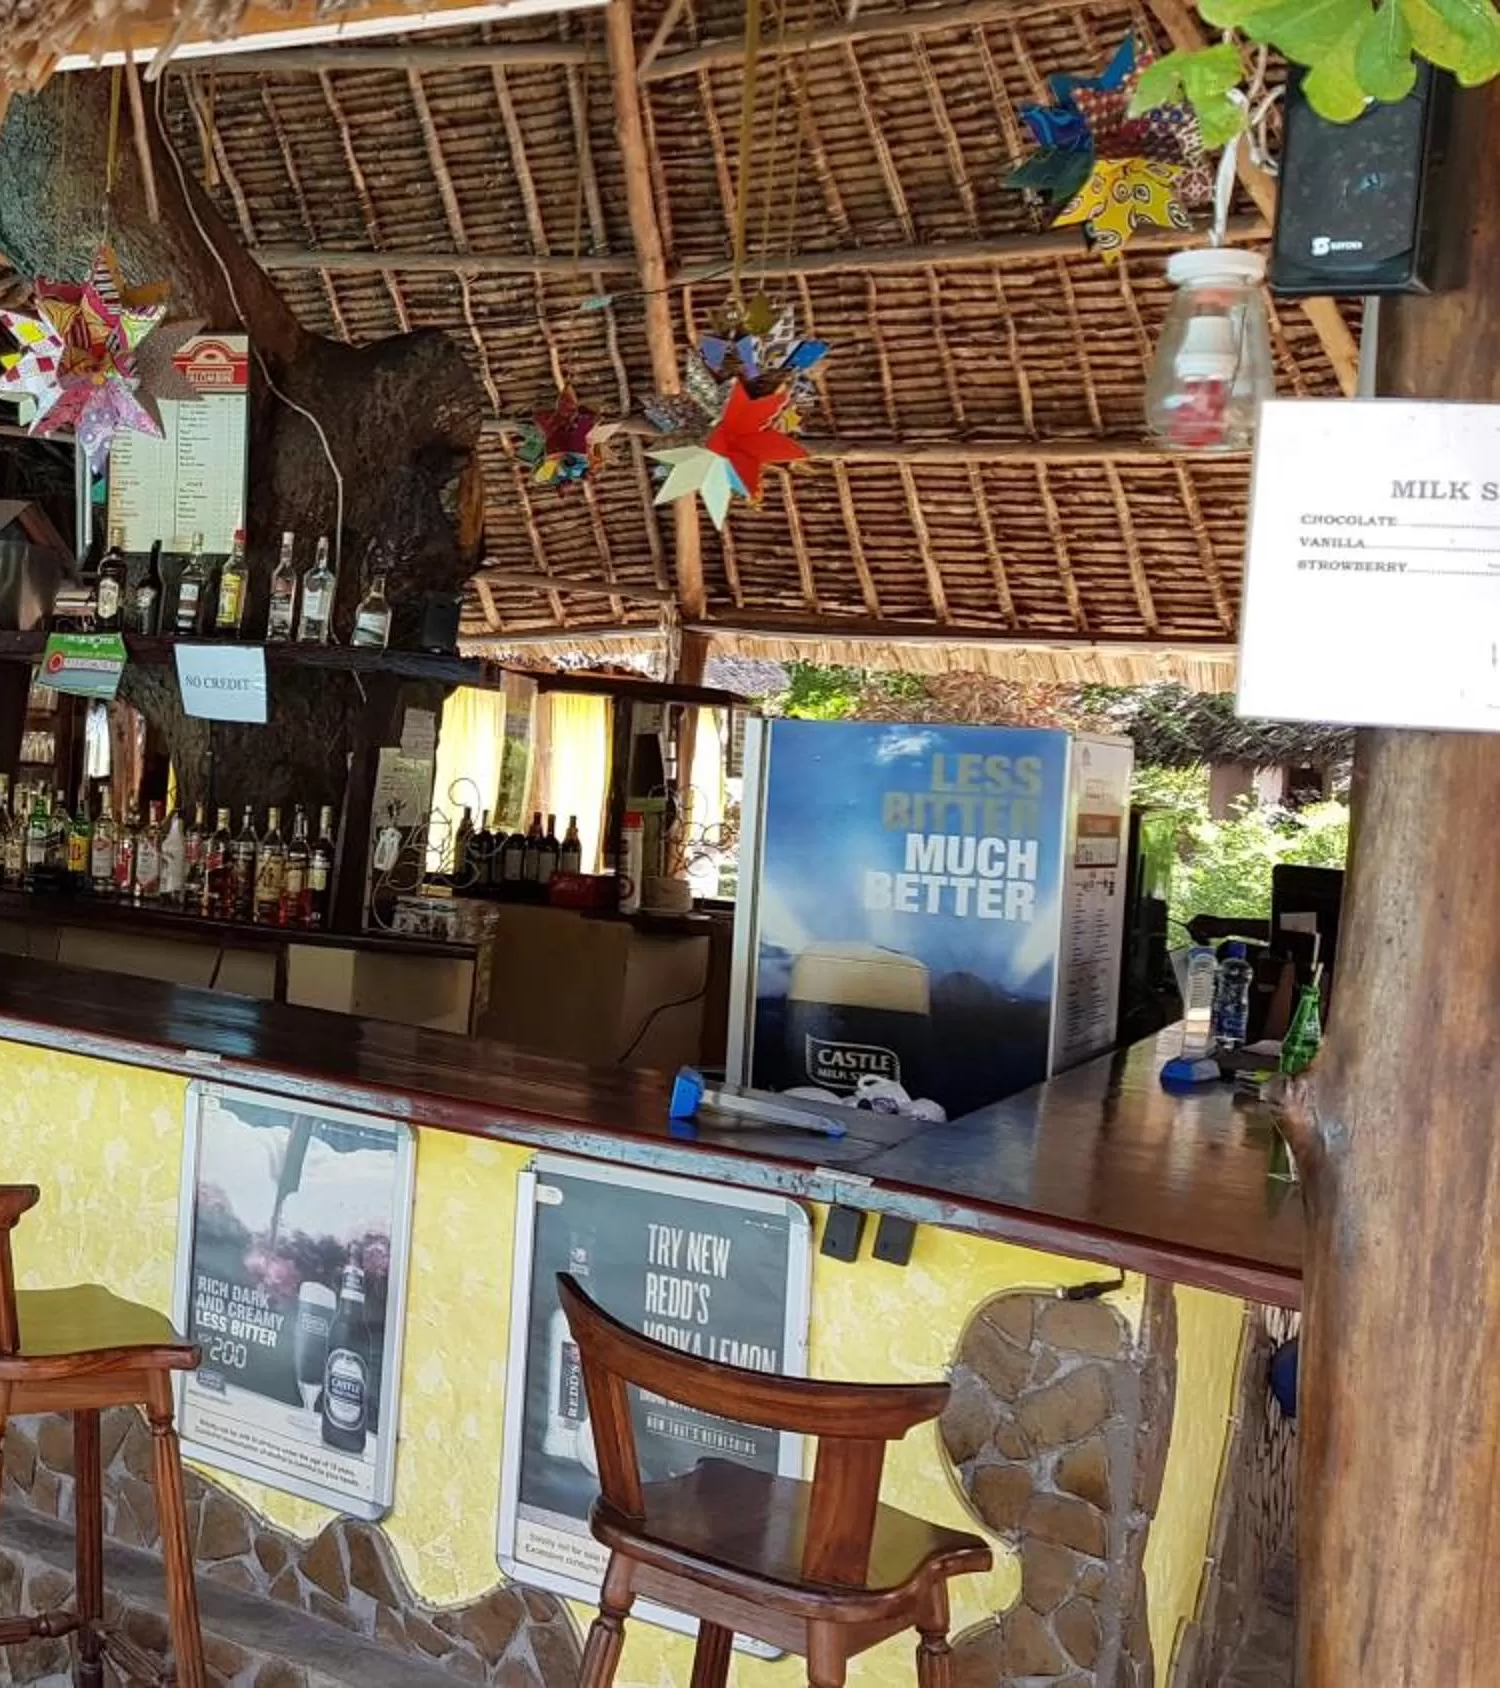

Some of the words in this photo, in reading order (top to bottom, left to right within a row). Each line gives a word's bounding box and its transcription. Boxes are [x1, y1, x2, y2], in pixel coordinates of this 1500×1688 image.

[1390, 479, 1471, 501] MILK
[1300, 513, 1398, 527] CHOCOLATE
[1299, 537, 1366, 549] VANILLA
[1297, 559, 1409, 573] STROWBERRY
[184, 674, 202, 688] NO
[203, 677, 250, 691] CREDIT
[931, 752, 1043, 797] LESS
[883, 791, 1041, 837] BITTER
[905, 833, 1039, 880] MUCH
[863, 871, 1036, 922] BETTER
[817, 1048, 892, 1071] CASTLE
[648, 1223, 684, 1269] TRY
[687, 1231, 731, 1279] NEW
[197, 1276, 229, 1299] RICH
[232, 1283, 269, 1310] DARK
[645, 1272, 711, 1325] REDD'S
[195, 1309, 228, 1333] LESS
[231, 1319, 278, 1347] BITTER
[197, 1293, 226, 1314] AND
[227, 1301, 284, 1332] CREAMY
[210, 1337, 247, 1369] 200
